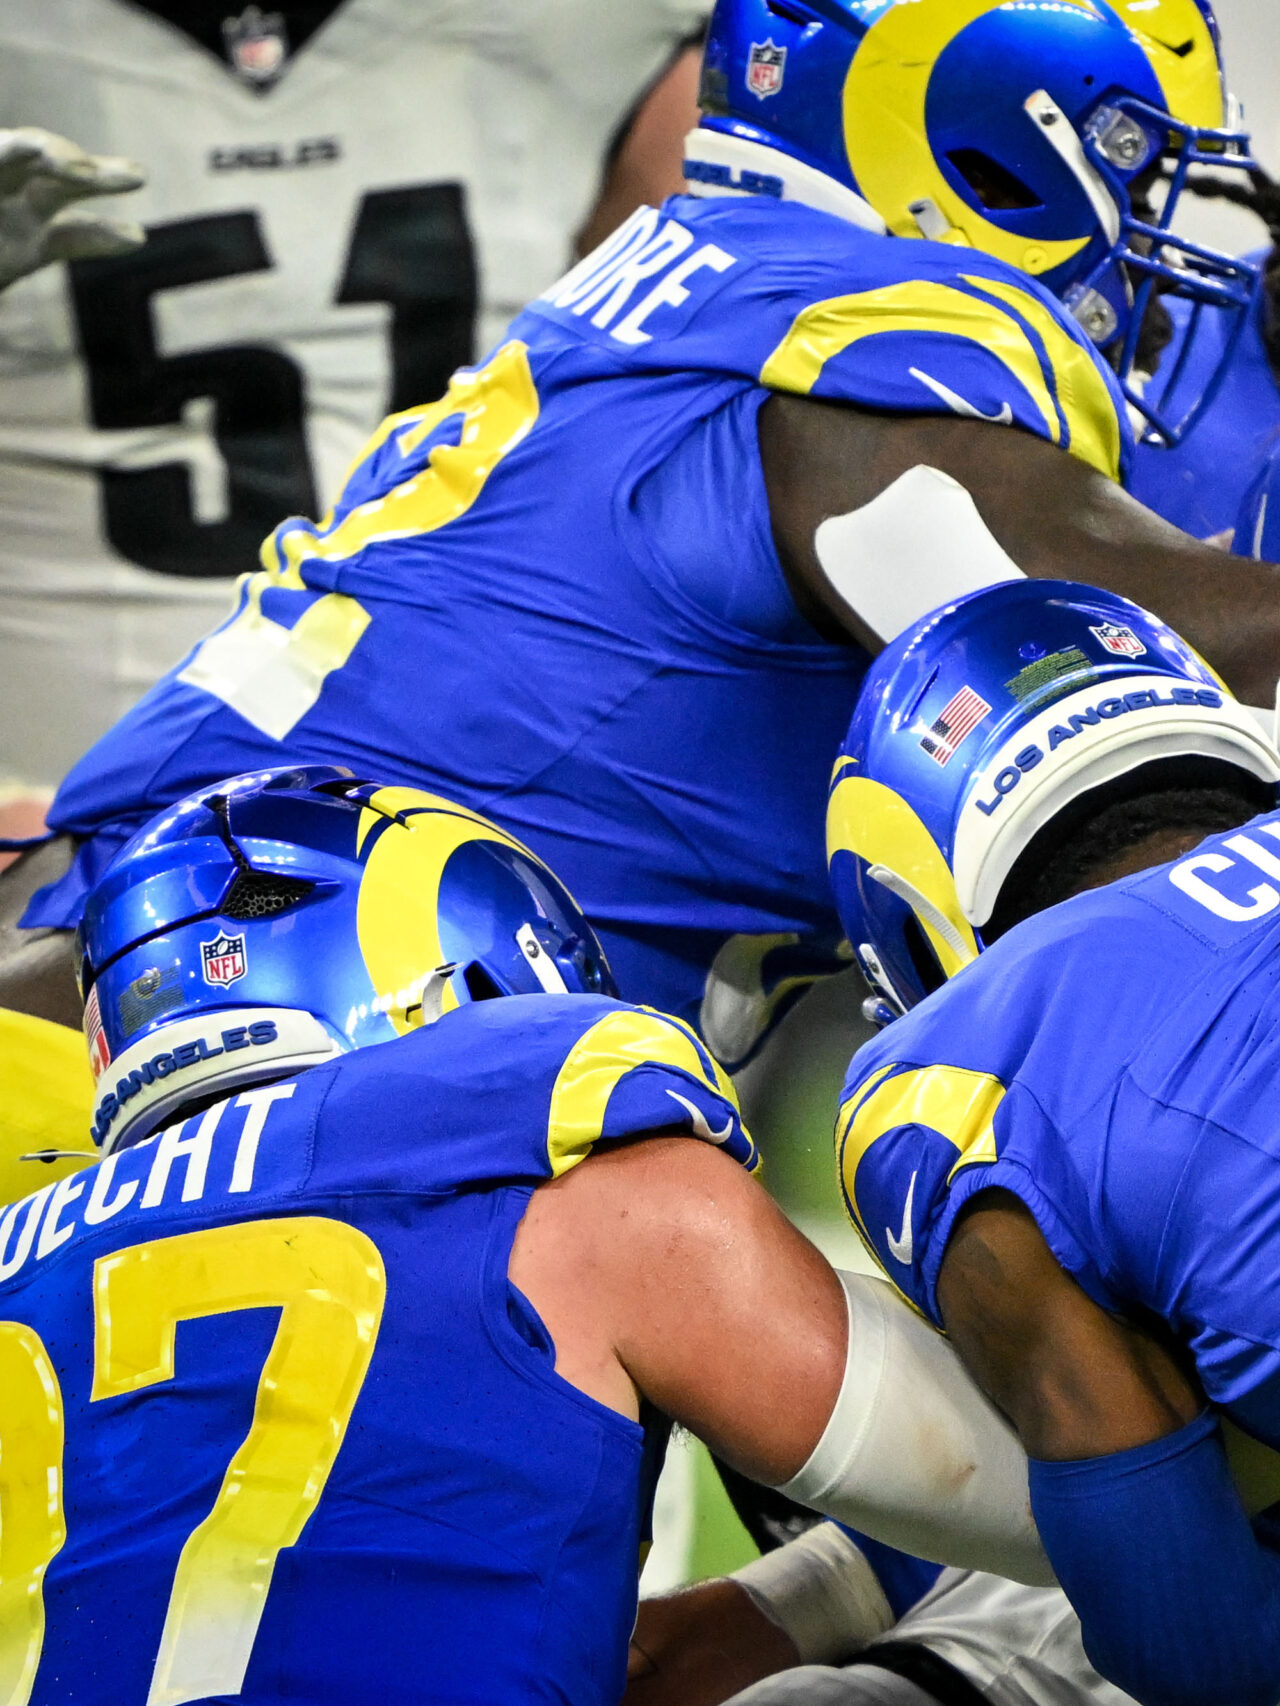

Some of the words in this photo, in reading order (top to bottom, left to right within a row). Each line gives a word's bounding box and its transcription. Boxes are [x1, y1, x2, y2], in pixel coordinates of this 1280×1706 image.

[209, 136, 341, 173] EAGLES
[65, 178, 482, 578] 51
[1104, 637, 1141, 651] NFL
[975, 743, 1044, 817] LOS
[1047, 687, 1223, 752] ANGELES
[208, 954, 242, 980] NFL
[116, 1020, 279, 1101] ANGELES
